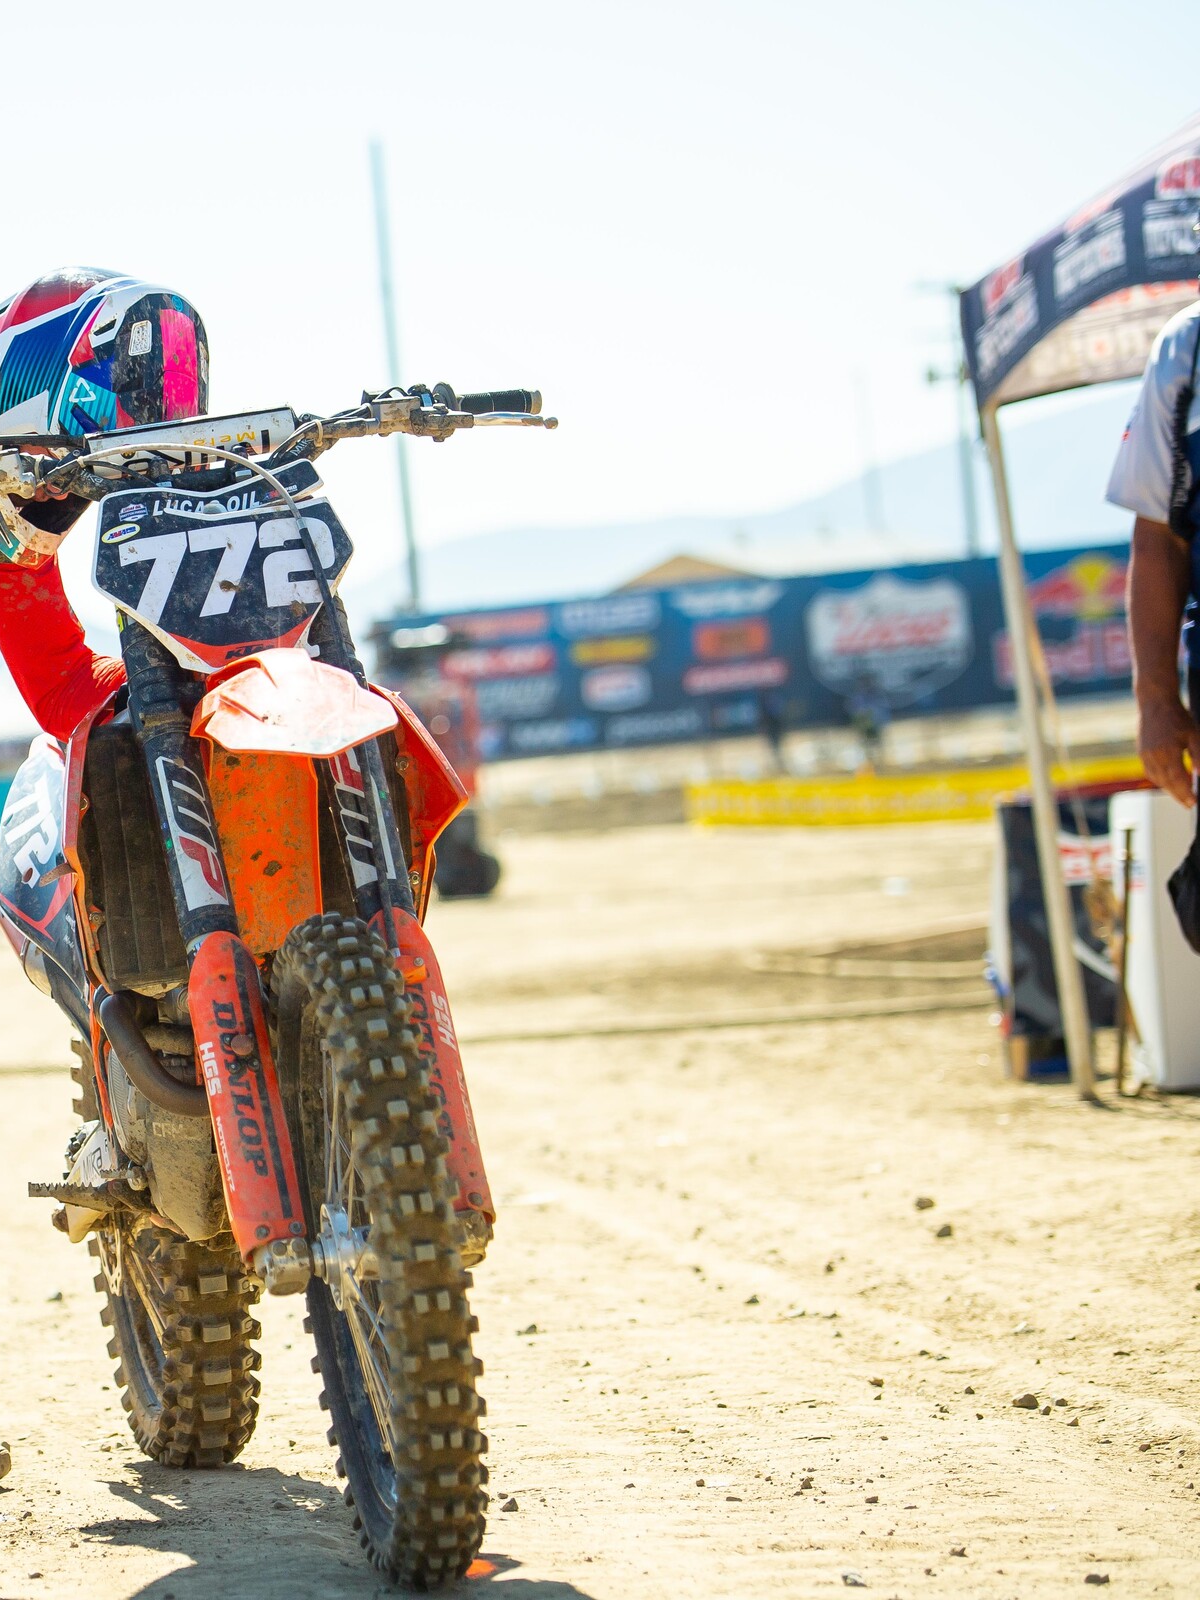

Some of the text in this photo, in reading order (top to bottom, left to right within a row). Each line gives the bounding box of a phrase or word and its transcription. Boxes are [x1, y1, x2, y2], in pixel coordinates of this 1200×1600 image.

[153, 491, 262, 516] LUCA OIL
[118, 516, 336, 625] 772
[430, 990, 457, 1052] HGS
[200, 1041, 222, 1097] HGS
[212, 1000, 269, 1177] DUNLOP
